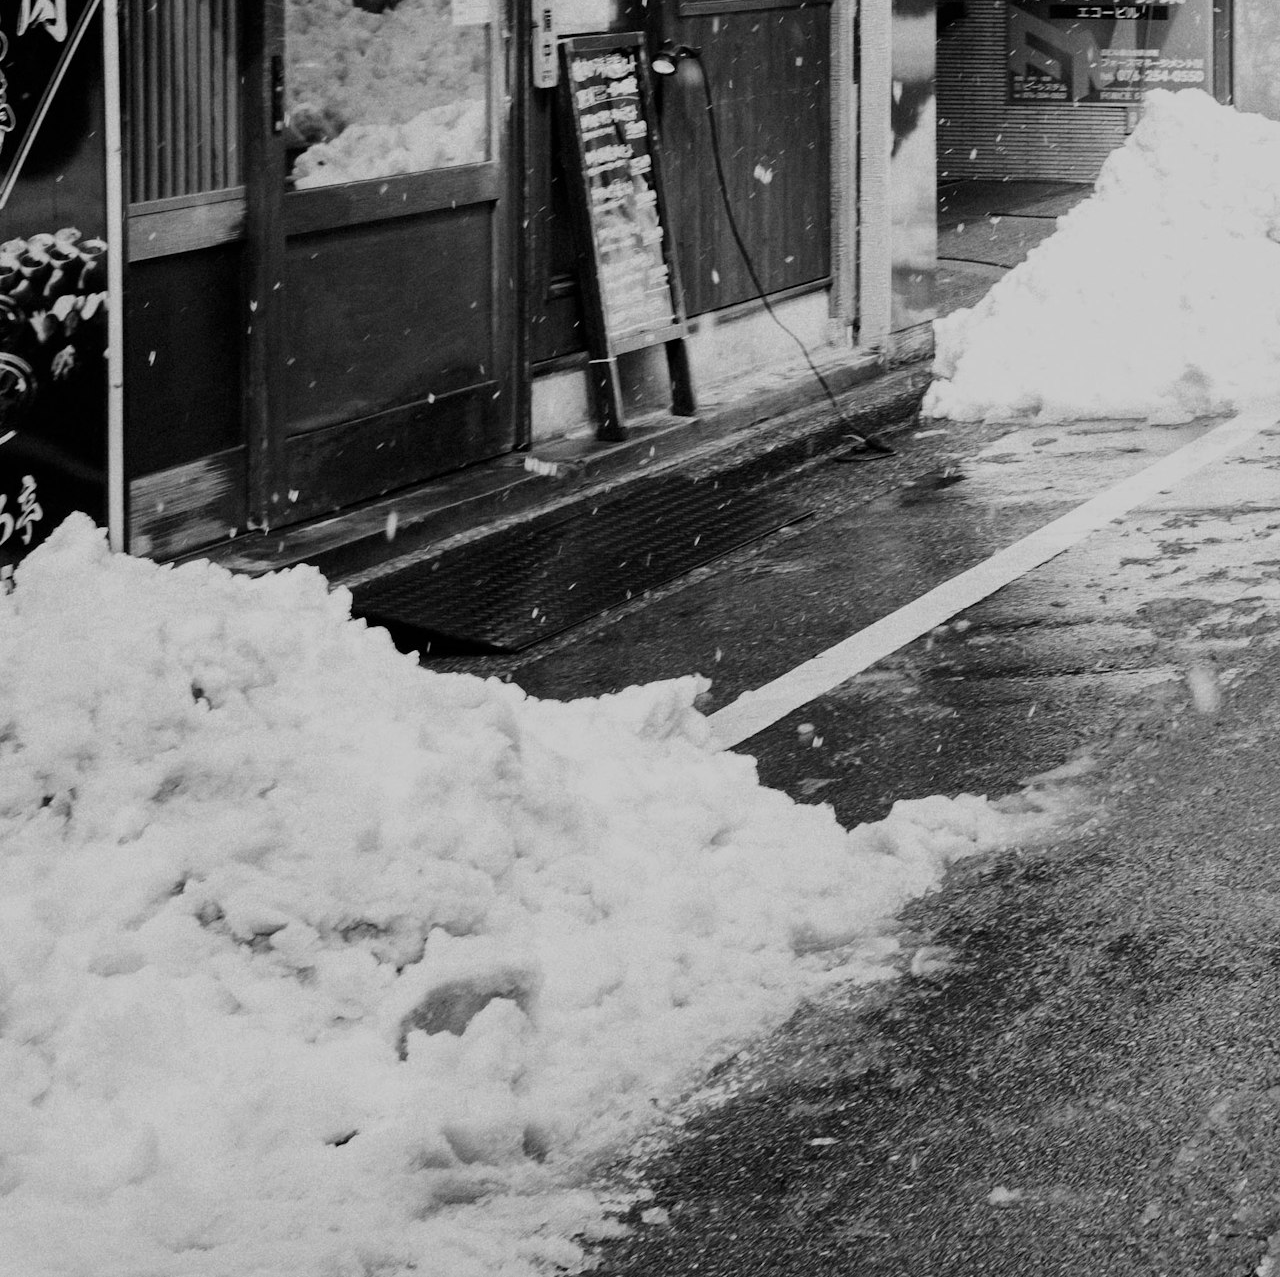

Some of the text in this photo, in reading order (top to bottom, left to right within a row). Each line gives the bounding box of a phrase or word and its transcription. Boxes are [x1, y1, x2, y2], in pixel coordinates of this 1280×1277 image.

[1077, 6, 1139, 19] エコービル
